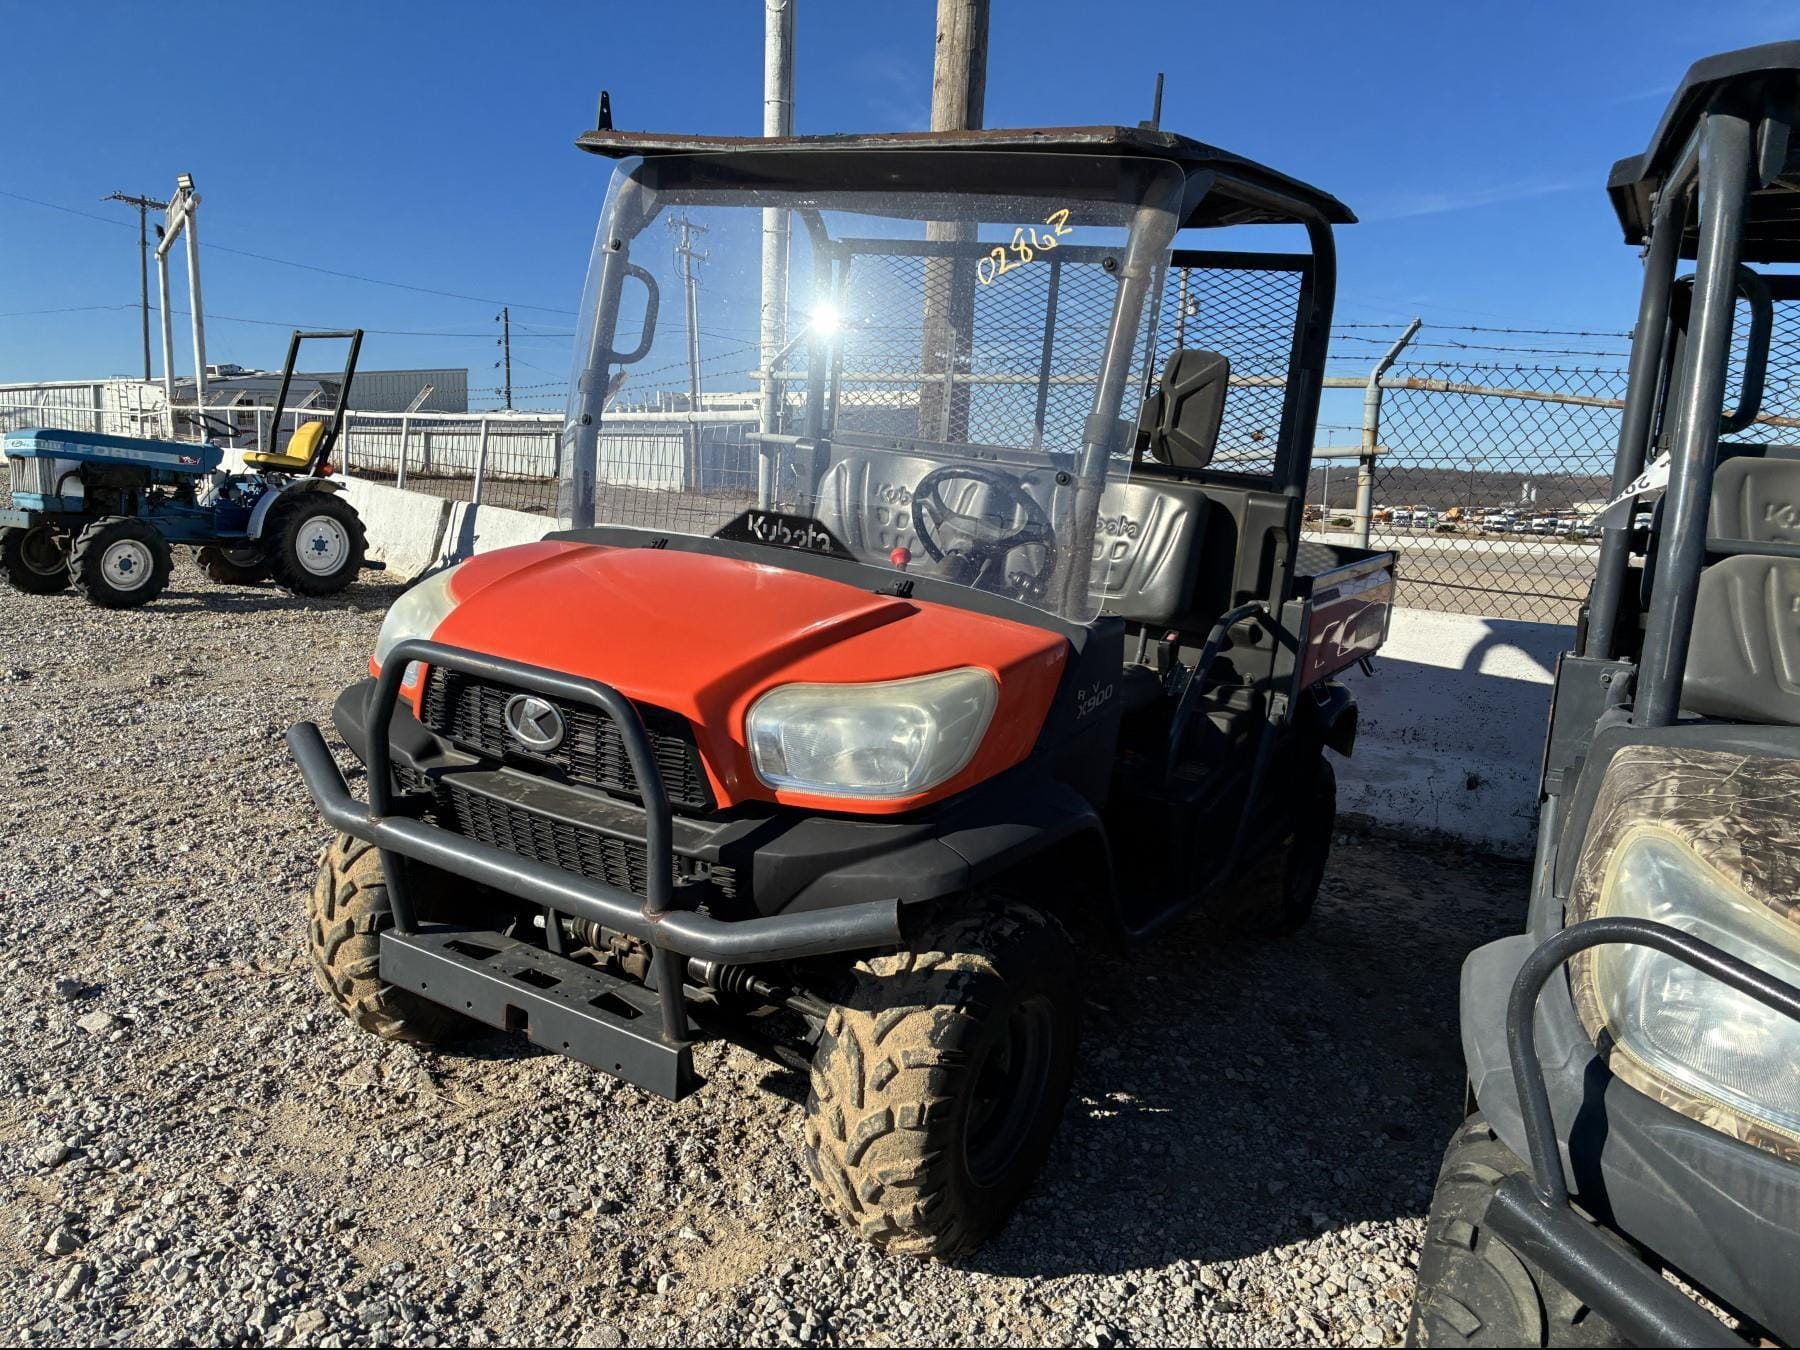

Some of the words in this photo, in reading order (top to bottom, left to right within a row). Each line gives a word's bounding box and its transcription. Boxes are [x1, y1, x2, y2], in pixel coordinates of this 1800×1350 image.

[977, 208, 1073, 285] 02862
[76, 444, 143, 460] FORD
[747, 513, 832, 553] Kubota
[1094, 510, 1140, 539] bota
[1076, 683, 1113, 720] X900
